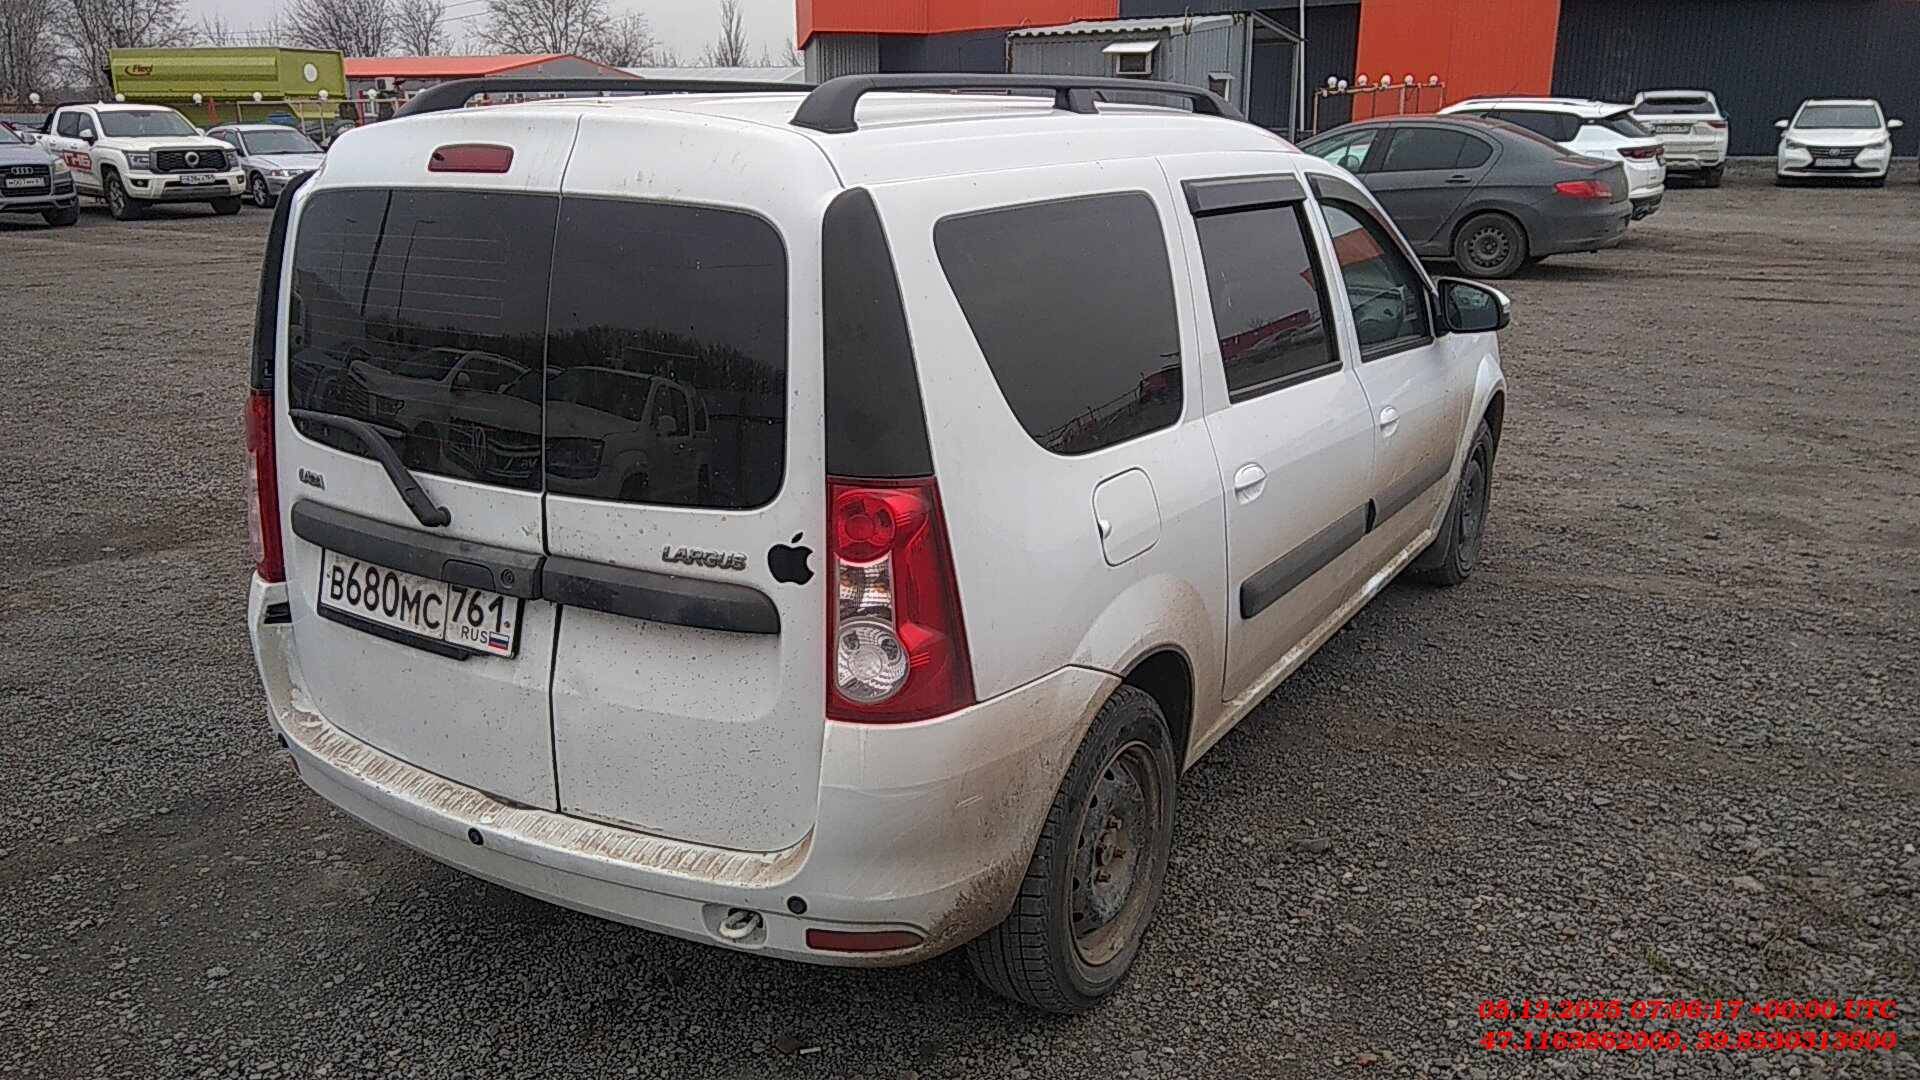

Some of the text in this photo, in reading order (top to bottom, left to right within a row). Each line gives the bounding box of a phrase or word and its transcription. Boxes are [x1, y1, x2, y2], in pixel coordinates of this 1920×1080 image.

[662, 546, 747, 571] LARGUS
[451, 586, 505, 633] 761
[461, 625, 488, 644] RUS
